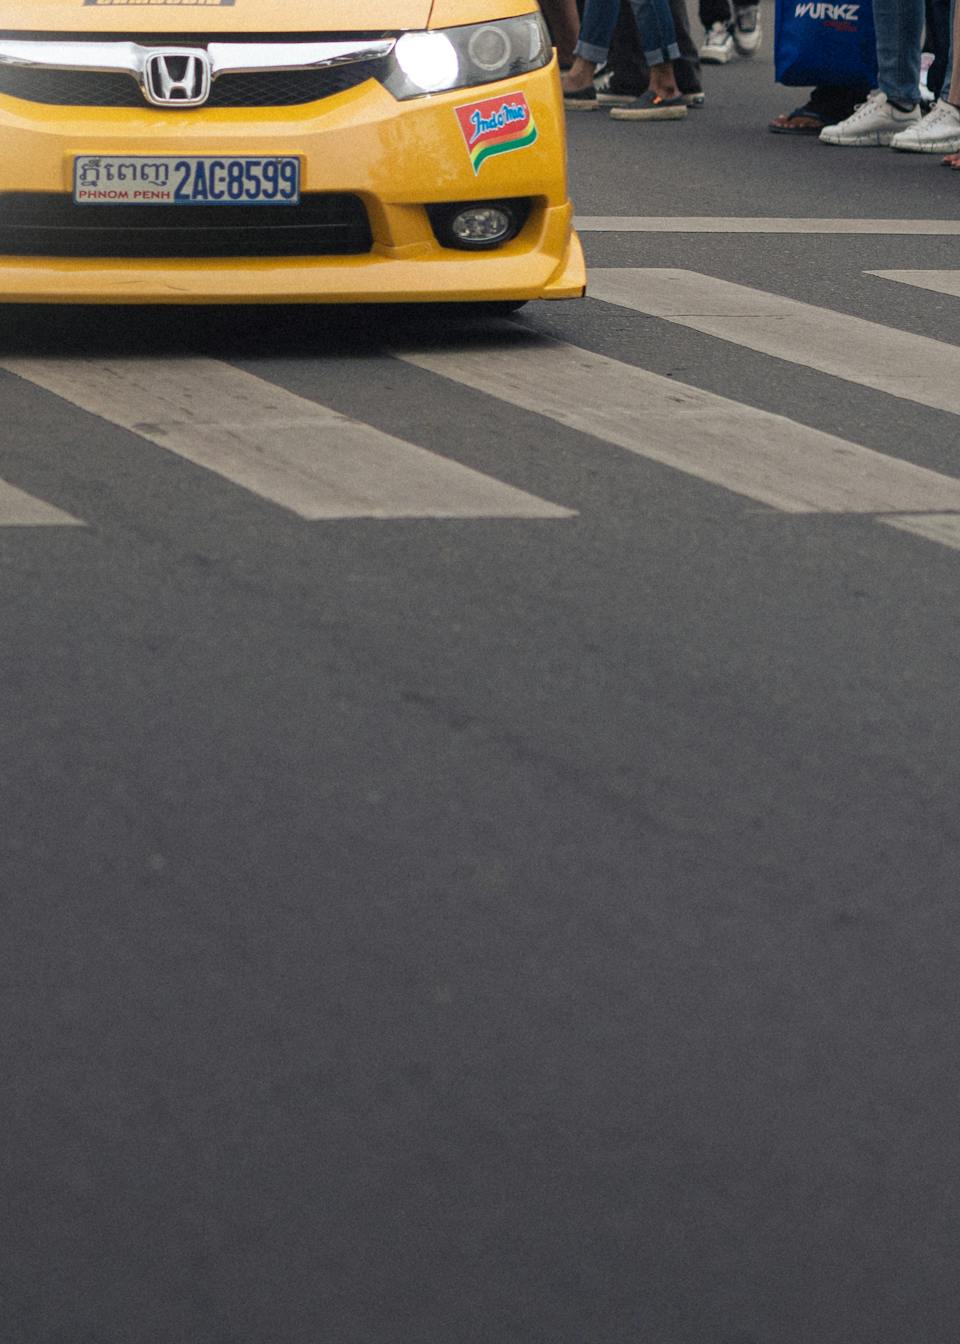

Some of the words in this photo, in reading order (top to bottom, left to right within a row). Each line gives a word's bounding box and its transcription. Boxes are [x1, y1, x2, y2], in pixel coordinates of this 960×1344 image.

[794, 2, 860, 20] WURKZ
[79, 190, 129, 199] PHNOM
[133, 190, 171, 199] PENH
